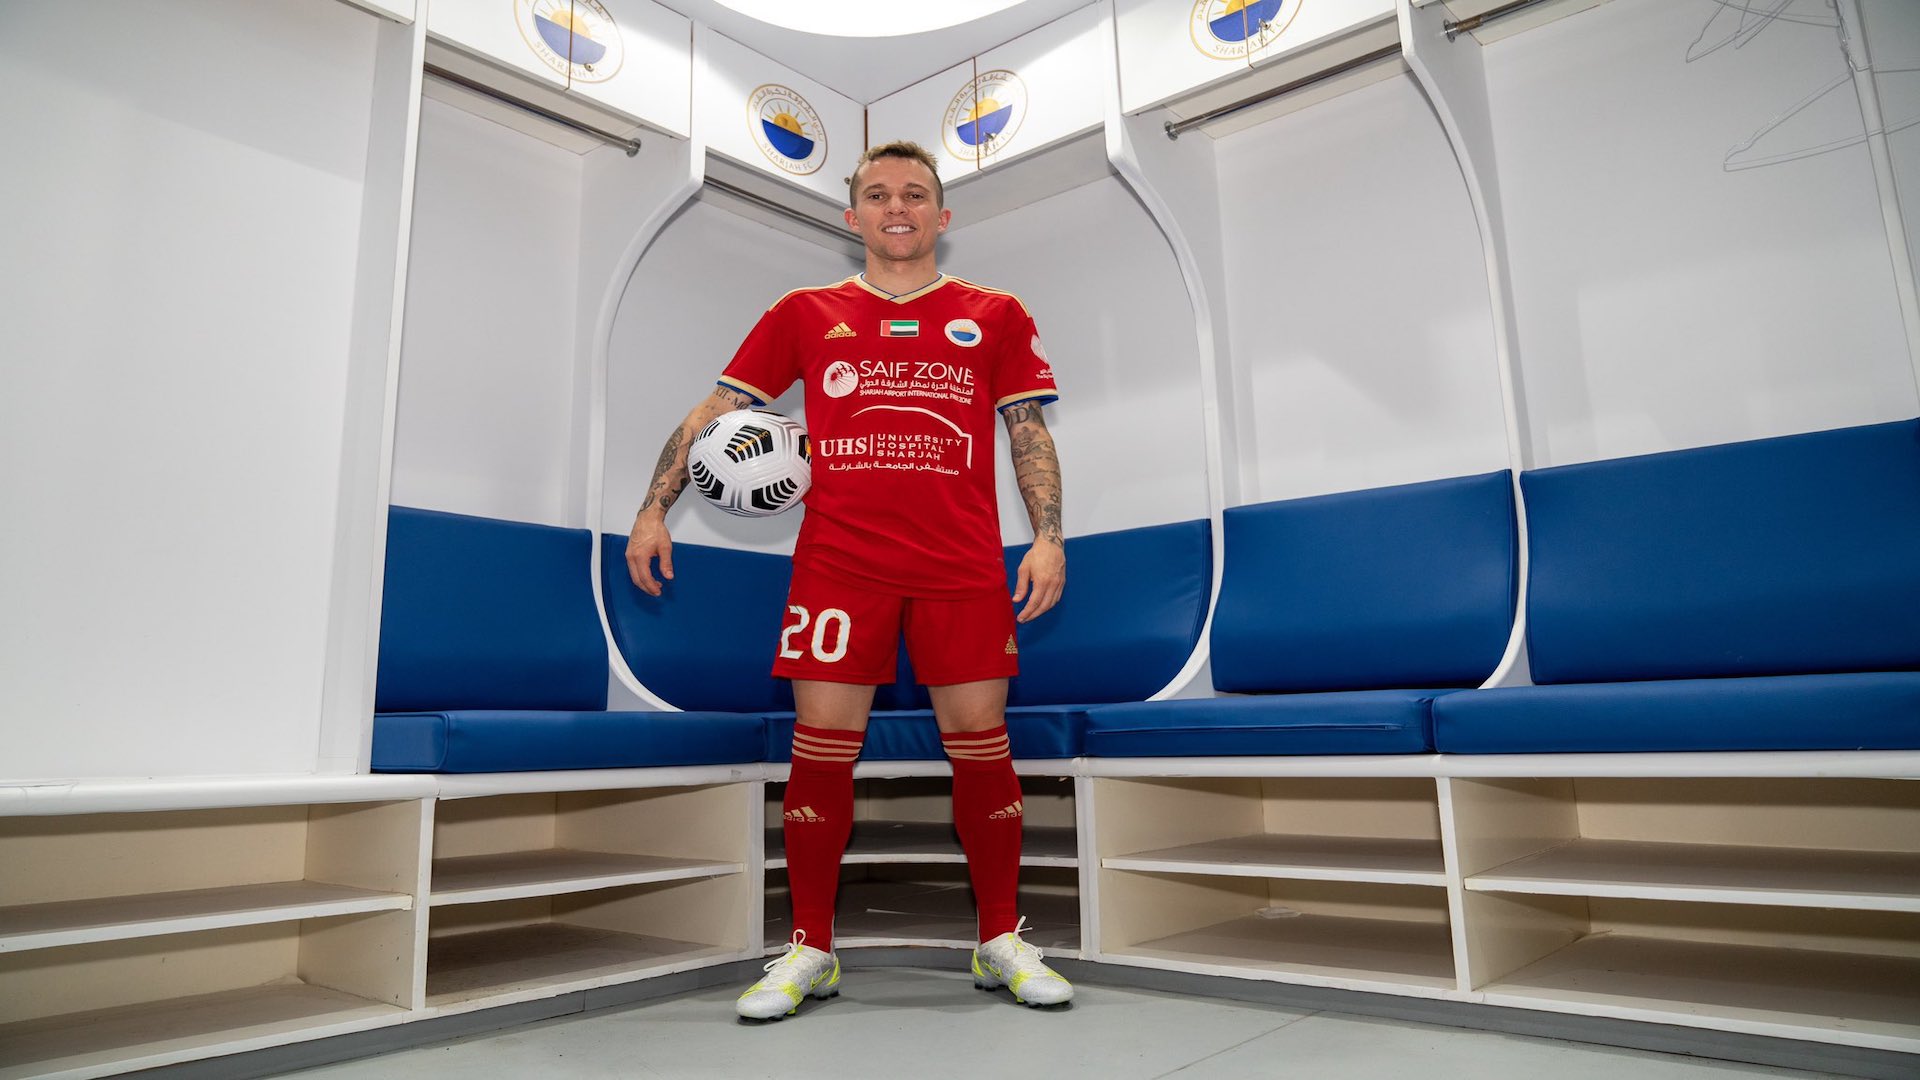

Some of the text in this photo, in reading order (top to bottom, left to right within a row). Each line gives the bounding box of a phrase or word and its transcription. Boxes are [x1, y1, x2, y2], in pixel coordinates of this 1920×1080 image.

[762, 142, 802, 171] SHARJAH
[824, 331, 857, 341] adidas
[859, 360, 975, 386] SAIF ZONE
[881, 379, 908, 389] الشارقة
[877, 433, 962, 447] UNIVERSITY
[819, 437, 868, 457] UHS
[877, 441, 945, 454] HOSPITAL
[877, 449, 940, 461] SHARJAH
[829, 461, 872, 471] بالشارقة
[873, 460, 914, 470] الجامعة
[779, 604, 851, 663] 20
